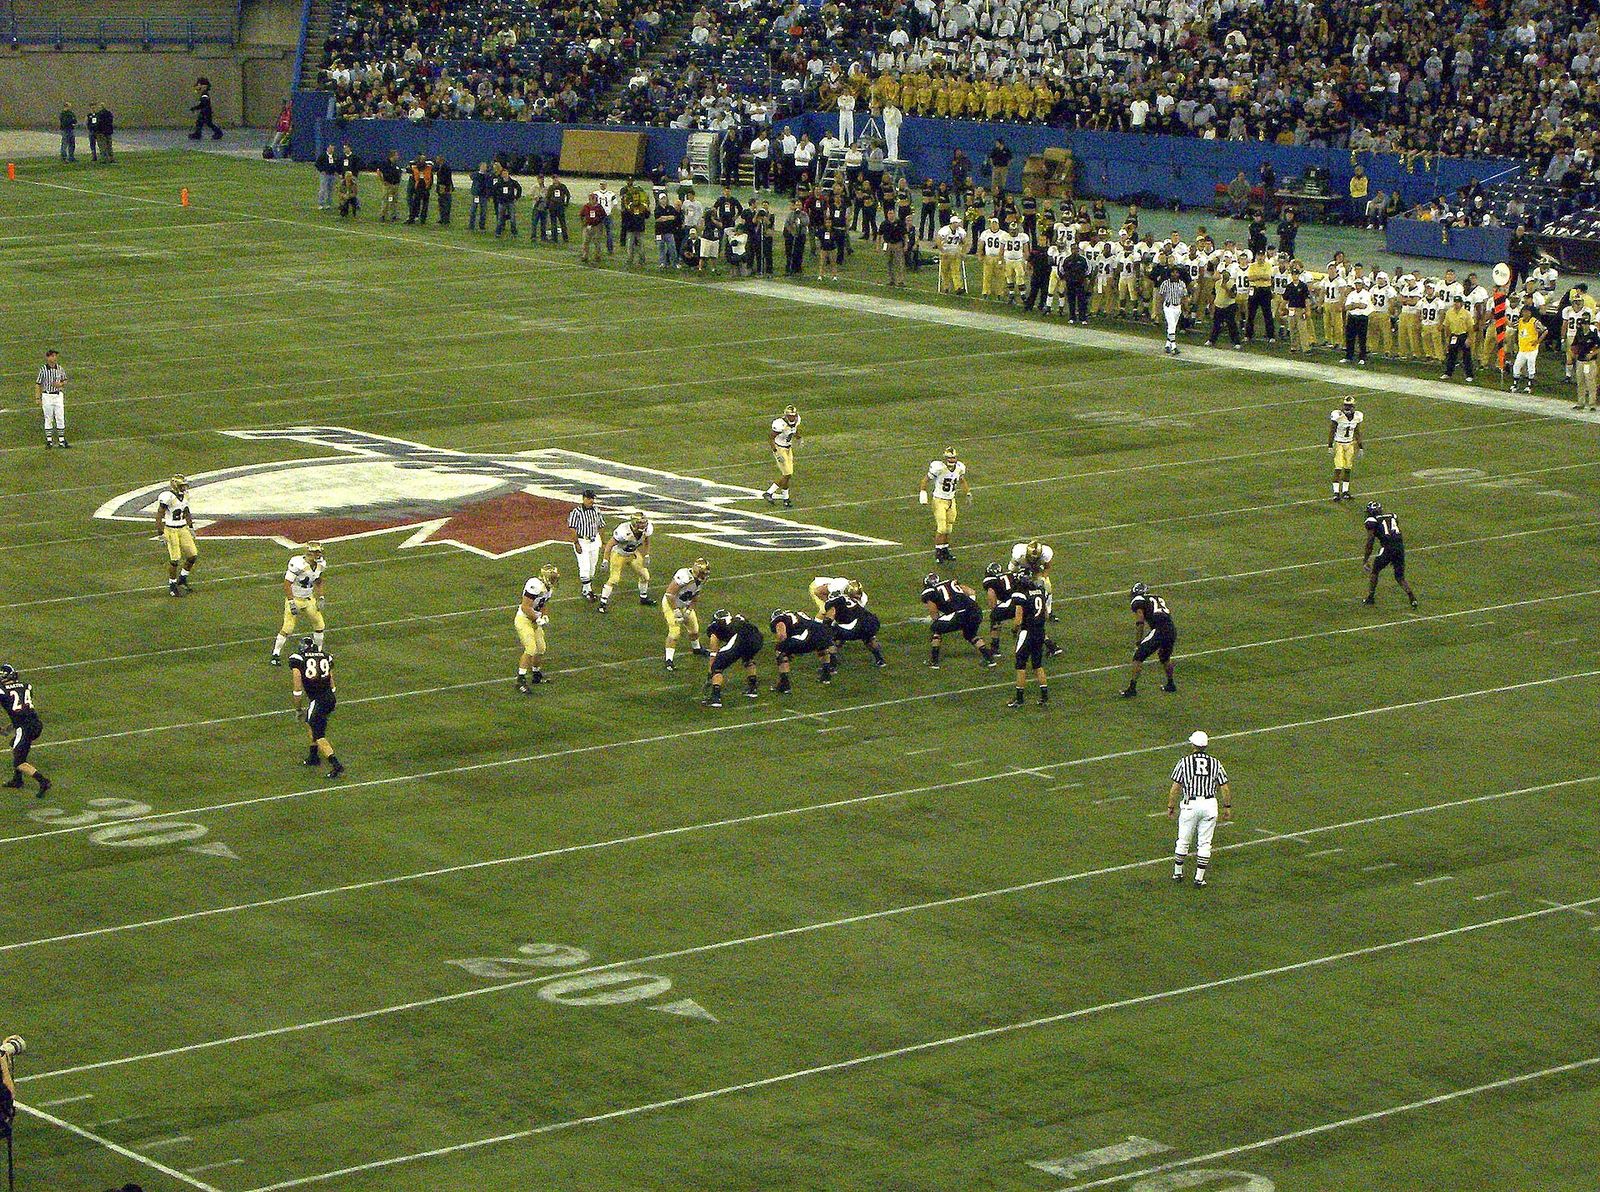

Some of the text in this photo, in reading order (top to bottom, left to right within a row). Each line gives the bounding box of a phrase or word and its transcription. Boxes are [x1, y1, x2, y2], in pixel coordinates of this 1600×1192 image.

[987, 237, 1000, 249] 66
[1060, 231, 1072, 241] 75
[1007, 240, 1020, 251] 63
[1422, 307, 1437, 321] 99
[1382, 517, 1401, 535] 14
[1034, 596, 1043, 618] 9
[1149, 596, 1170, 614] 23
[305, 657, 330, 679] 89
[9, 689, 35, 711] 24
[1194, 757, 1210, 776] R
[27, 797, 209, 847] 30
[444, 942, 672, 1006] 20
